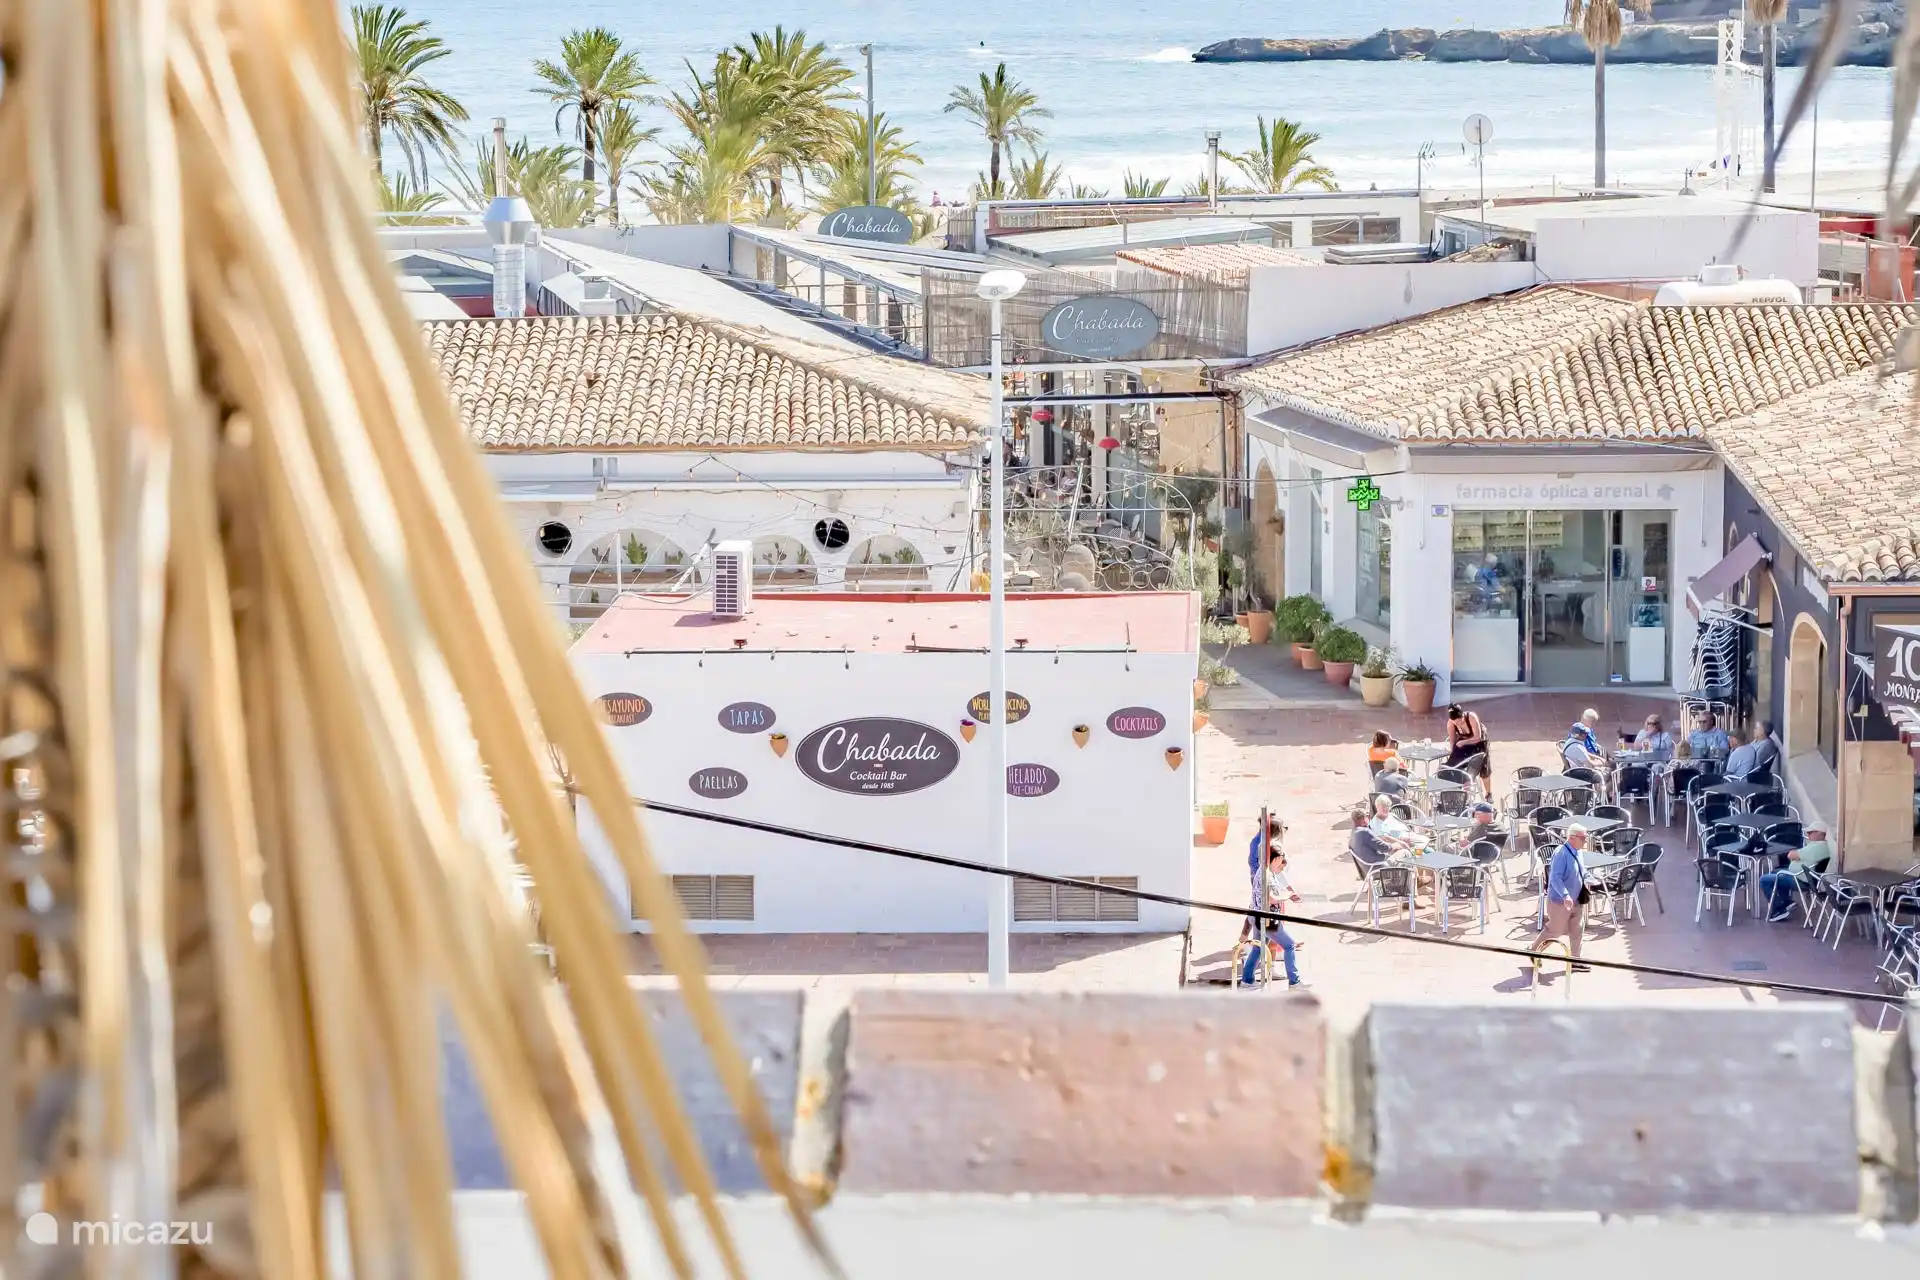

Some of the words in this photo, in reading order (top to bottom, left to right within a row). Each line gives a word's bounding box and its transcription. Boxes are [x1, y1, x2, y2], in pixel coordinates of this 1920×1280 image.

[830, 213, 902, 239] Chabada
[1053, 306, 1145, 340] Chabada
[1456, 484, 1533, 499] farmacia
[1540, 484, 1588, 501] óptica
[1594, 483, 1648, 499] arenal
[730, 709, 765, 726] TAPAS
[1114, 716, 1158, 731] COCKTAILS
[817, 727, 940, 773] Chabada
[699, 774, 738, 789] PAELLAS
[850, 771, 888, 781] Cocktail
[890, 771, 907, 781] Bar
[1008, 766, 1047, 784] HELADOS
